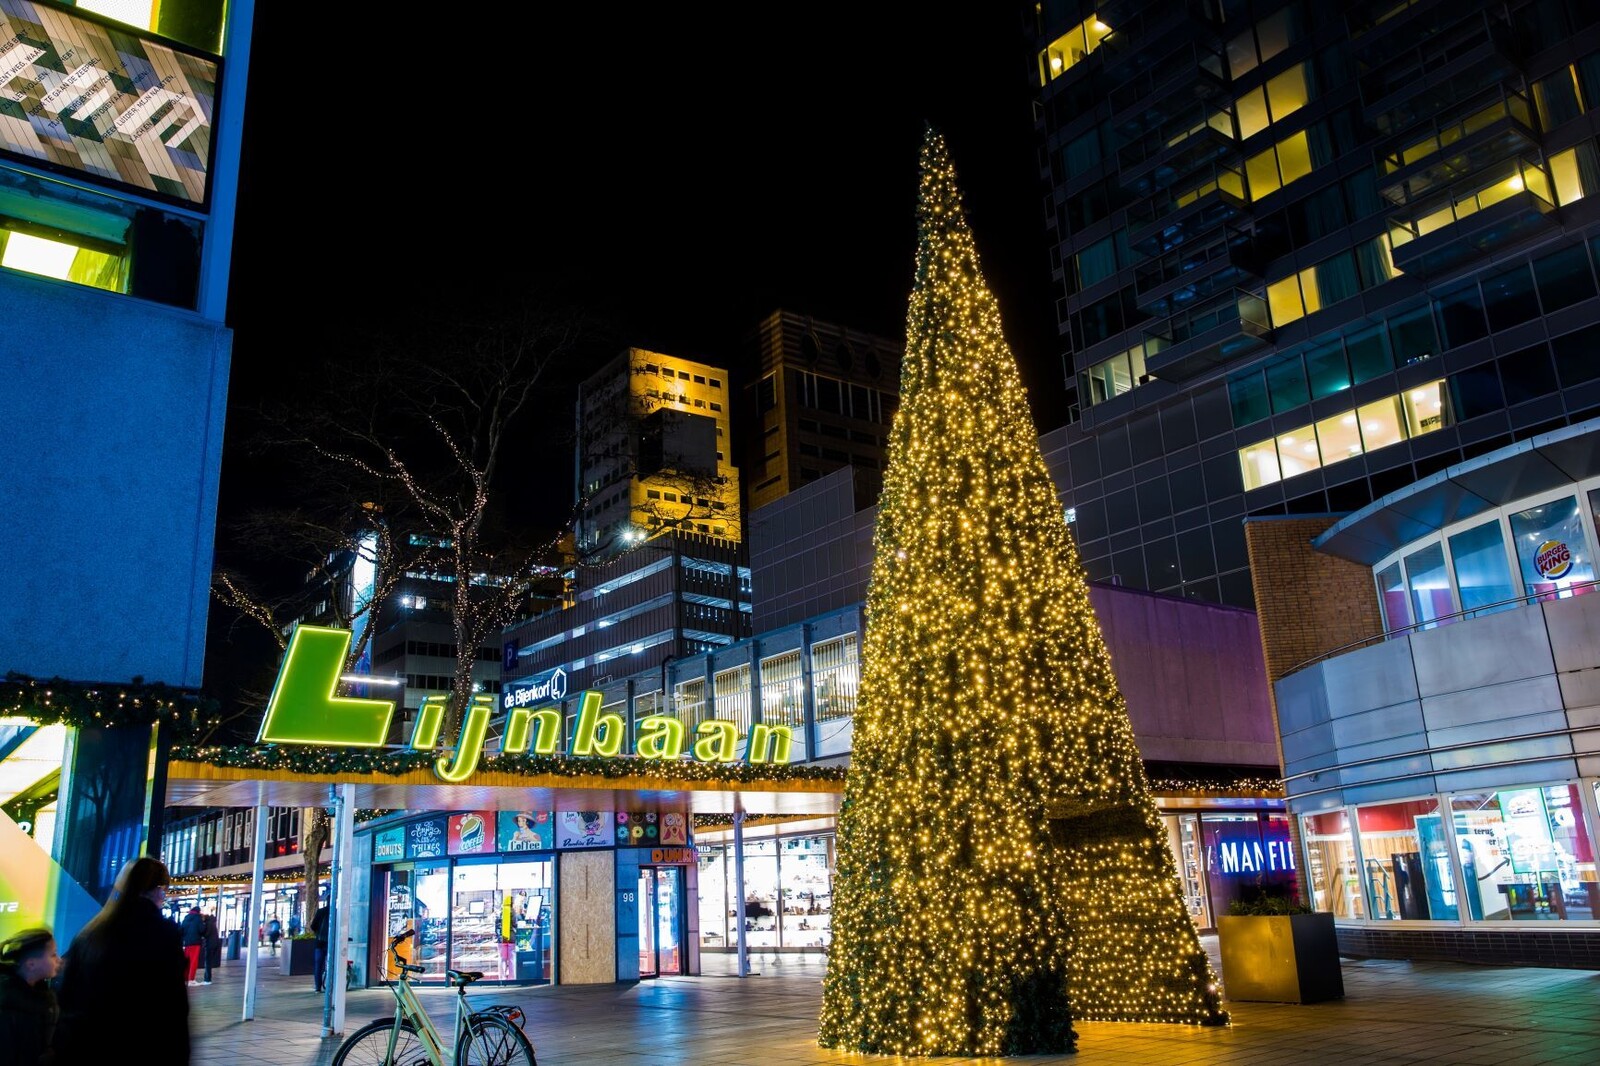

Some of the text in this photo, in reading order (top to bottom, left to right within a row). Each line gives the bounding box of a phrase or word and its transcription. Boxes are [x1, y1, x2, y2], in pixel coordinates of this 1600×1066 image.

[44, 94, 54, 104] TE
[51, 81, 70, 97] GAAN
[67, 74, 77, 84] DE
[135, 93, 153, 109] MIJN
[128, 126, 146, 142] LACH
[142, 120, 152, 130] EN
[1537, 543, 1570, 574] BURGER KING
[507, 648, 513, 667] P
[257, 624, 793, 783] Lijnbaan
[504, 680, 551, 709] de Bijenkorf
[1474, 828, 1494, 837] terug
[377, 843, 402, 857] DONUTS
[411, 842, 441, 857] THINGS
[462, 834, 485, 852] COFFEE
[511, 840, 540, 851] Coffee
[623, 893, 634, 903] 98
